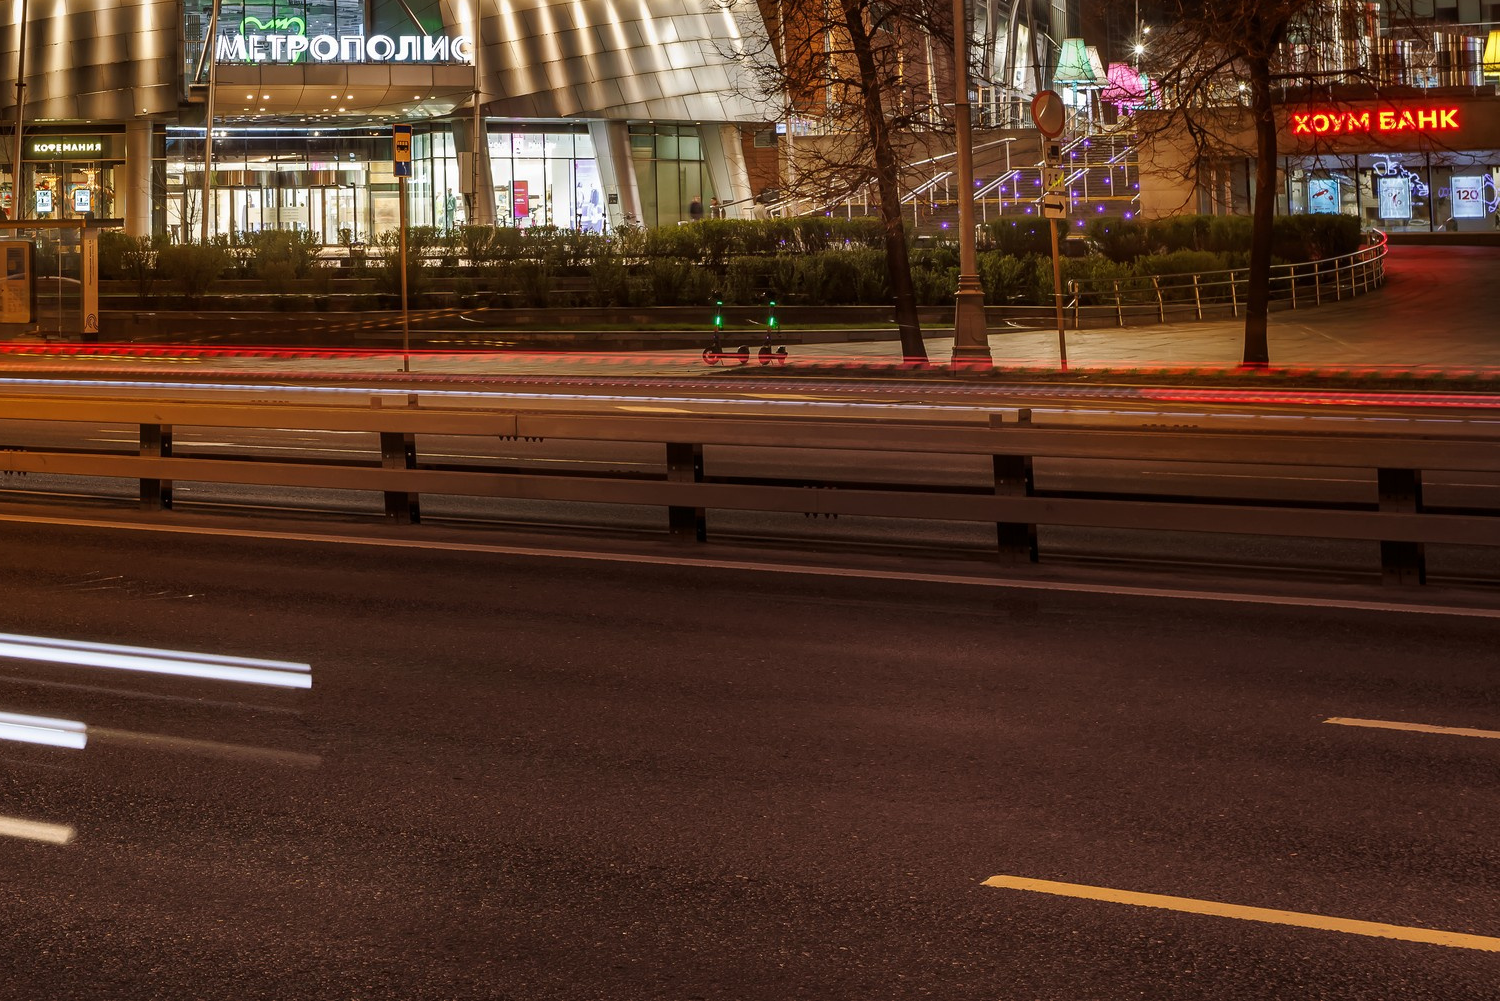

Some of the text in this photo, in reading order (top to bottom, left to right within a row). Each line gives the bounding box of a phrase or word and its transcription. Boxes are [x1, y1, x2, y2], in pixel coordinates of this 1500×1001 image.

[216, 34, 472, 61] МЕТРОПОЛИС
[1293, 109, 1459, 134] ХОУМ БАНК
[34, 143, 102, 152] КОФЕМАНИЯ
[1456, 190, 1479, 200] 120
